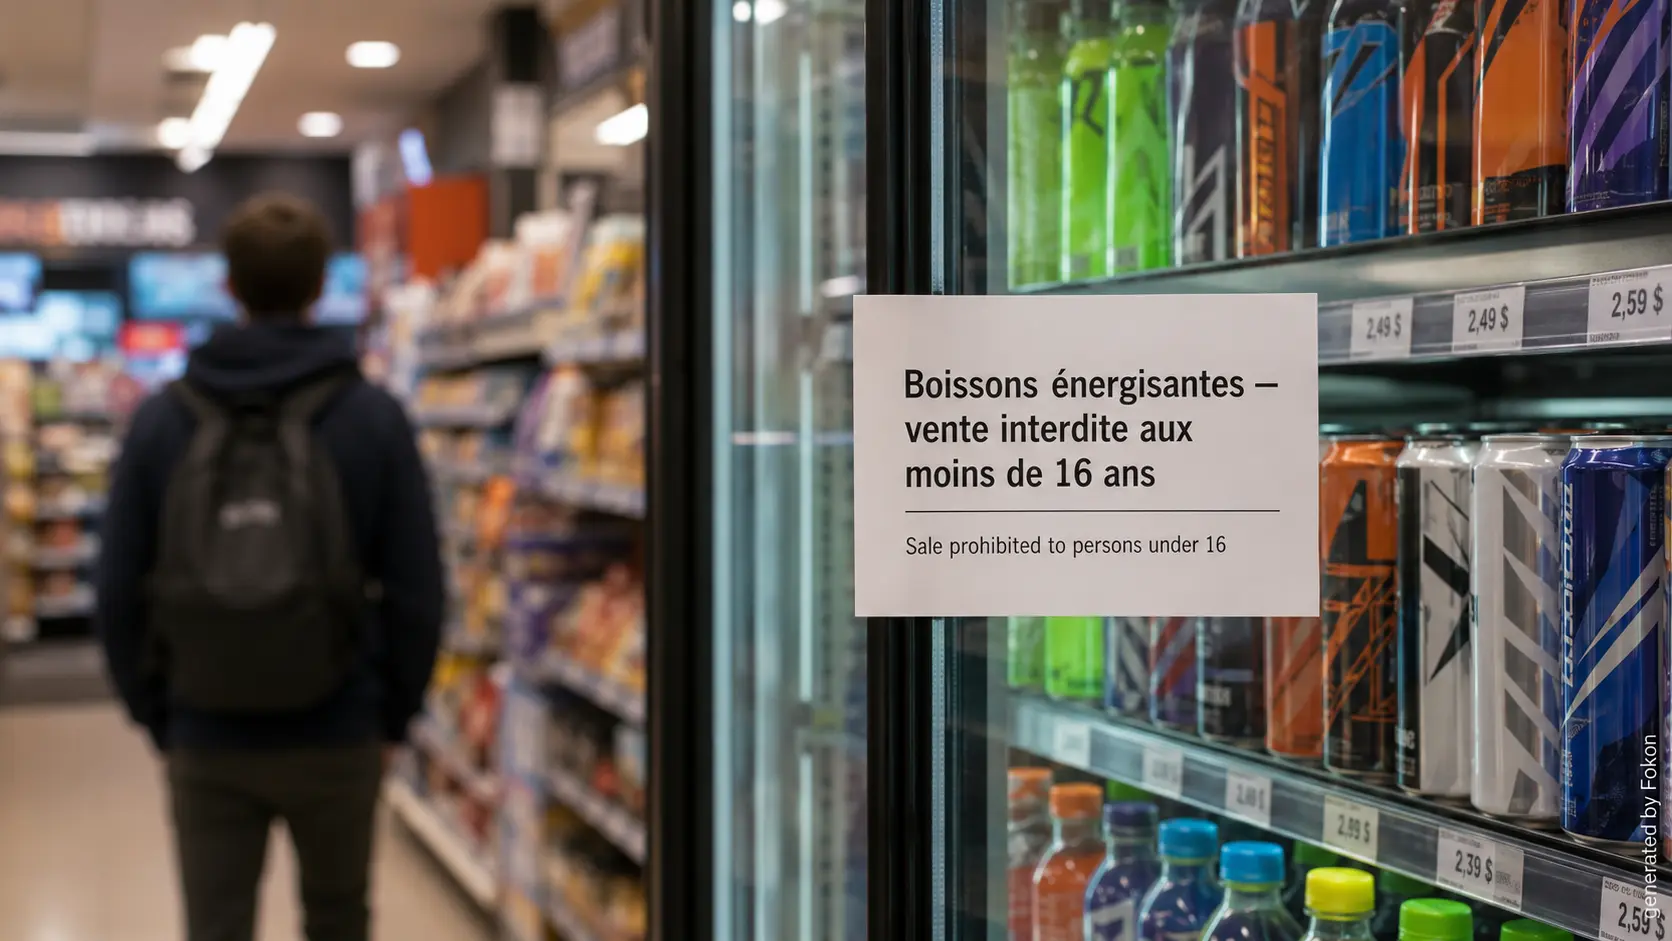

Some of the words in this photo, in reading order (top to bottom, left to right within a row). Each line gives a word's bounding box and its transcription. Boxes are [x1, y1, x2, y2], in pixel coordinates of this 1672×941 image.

[1468, 307, 1496, 336] 2,49
[1500, 302, 1509, 333] $
[1611, 288, 1647, 322] 2,59
[1653, 283, 1664, 316] $
[1366, 315, 1391, 342] 2,49
[1394, 312, 1402, 339] $
[904, 368, 1038, 399] Boissons
[1051, 368, 1245, 406] énergisantes
[905, 415, 989, 443] vente
[1001, 412, 1129, 443] interdite
[1140, 420, 1194, 443] aux
[906, 458, 995, 488] moins
[1006, 457, 1043, 488] de
[1056, 457, 1093, 488] 16
[1103, 465, 1156, 488] ans
[905, 536, 943, 556] Sale
[949, 535, 1041, 560] prohibited
[1047, 537, 1066, 554] to
[1073, 539, 1143, 559] persons
[1148, 535, 1200, 554] under
[1206, 535, 1227, 554] 16
[1455, 849, 1482, 878] 2,39
[1485, 856, 1493, 884] $
[1618, 901, 1650, 935] 2,59
[1655, 909, 1666, 941] $
